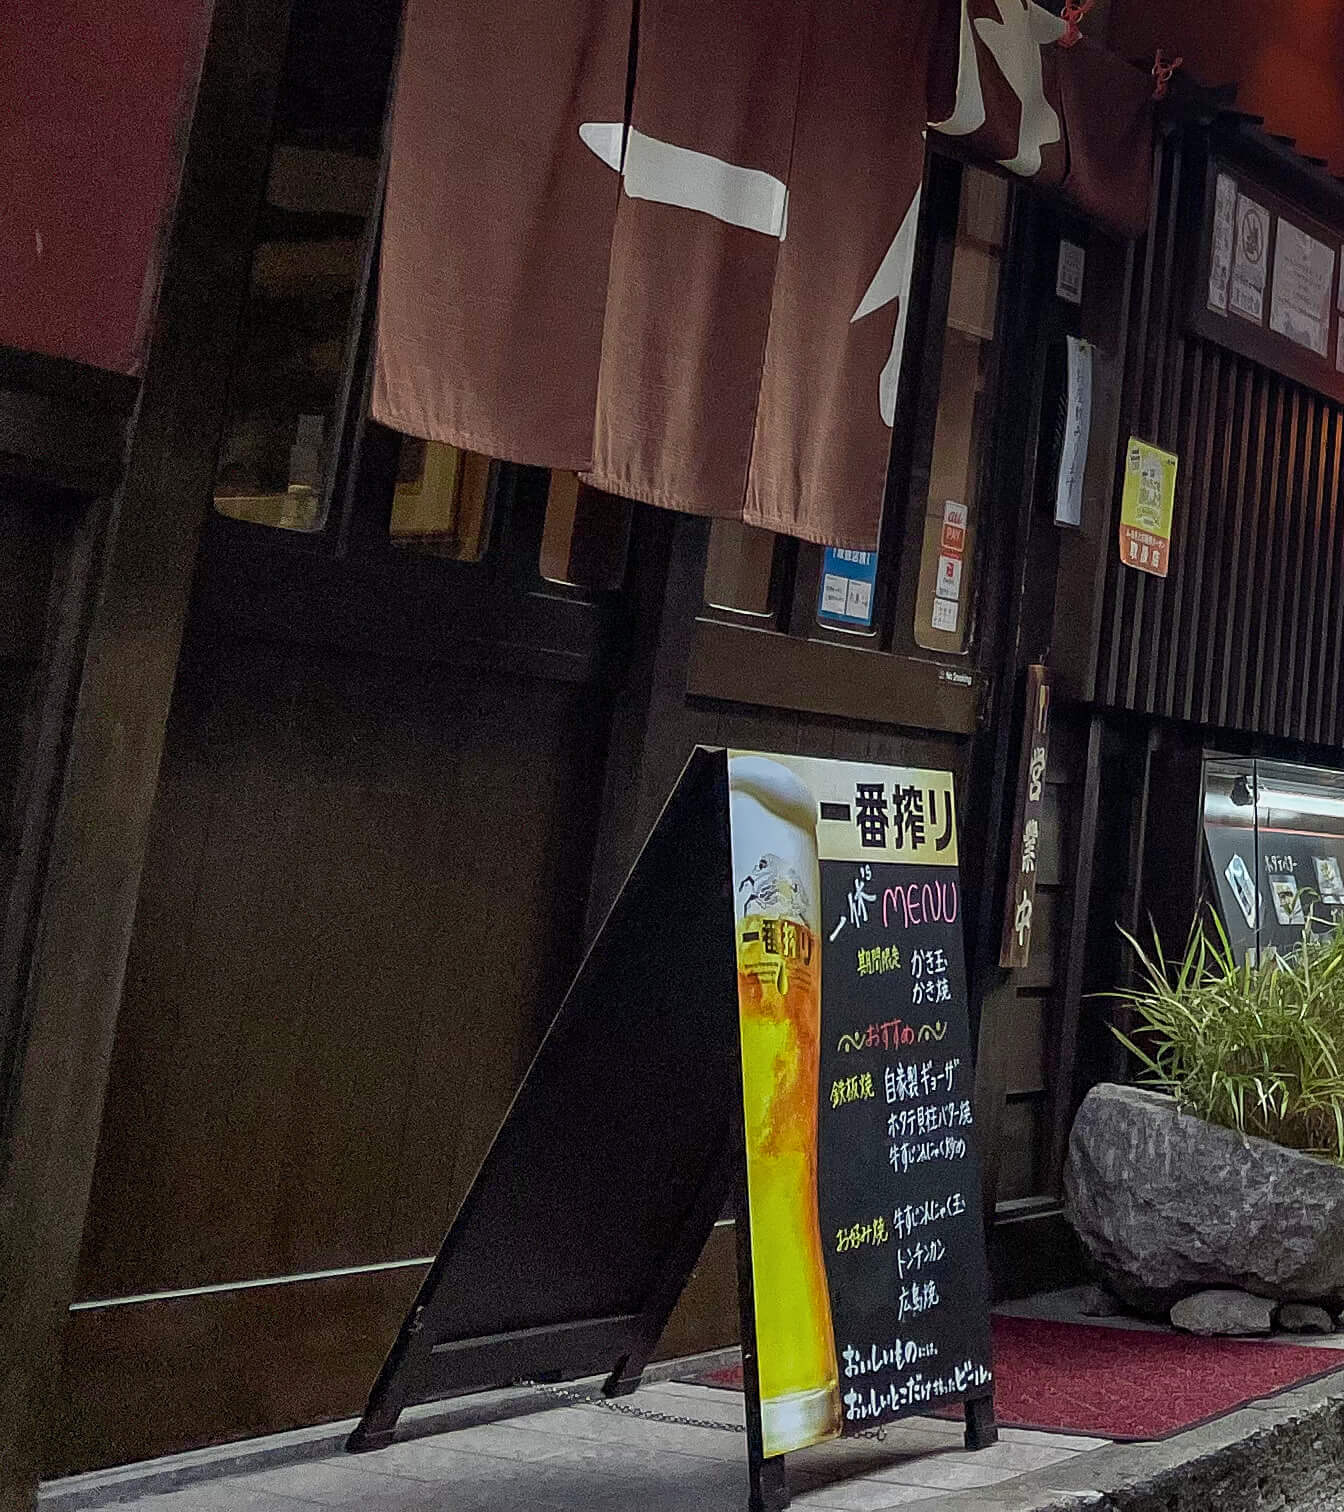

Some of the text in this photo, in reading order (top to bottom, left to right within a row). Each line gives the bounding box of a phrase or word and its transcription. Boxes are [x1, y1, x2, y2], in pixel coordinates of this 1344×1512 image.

[820, 783, 954, 851] 一番搾り
[882, 881, 957, 928] MENU
[857, 945, 948, 978] 期間限定 かき玉
[830, 1072, 876, 1109] 鉄板焼
[836, 1216, 888, 1253] お好み焼
[898, 1280, 940, 1321] 広島焼
